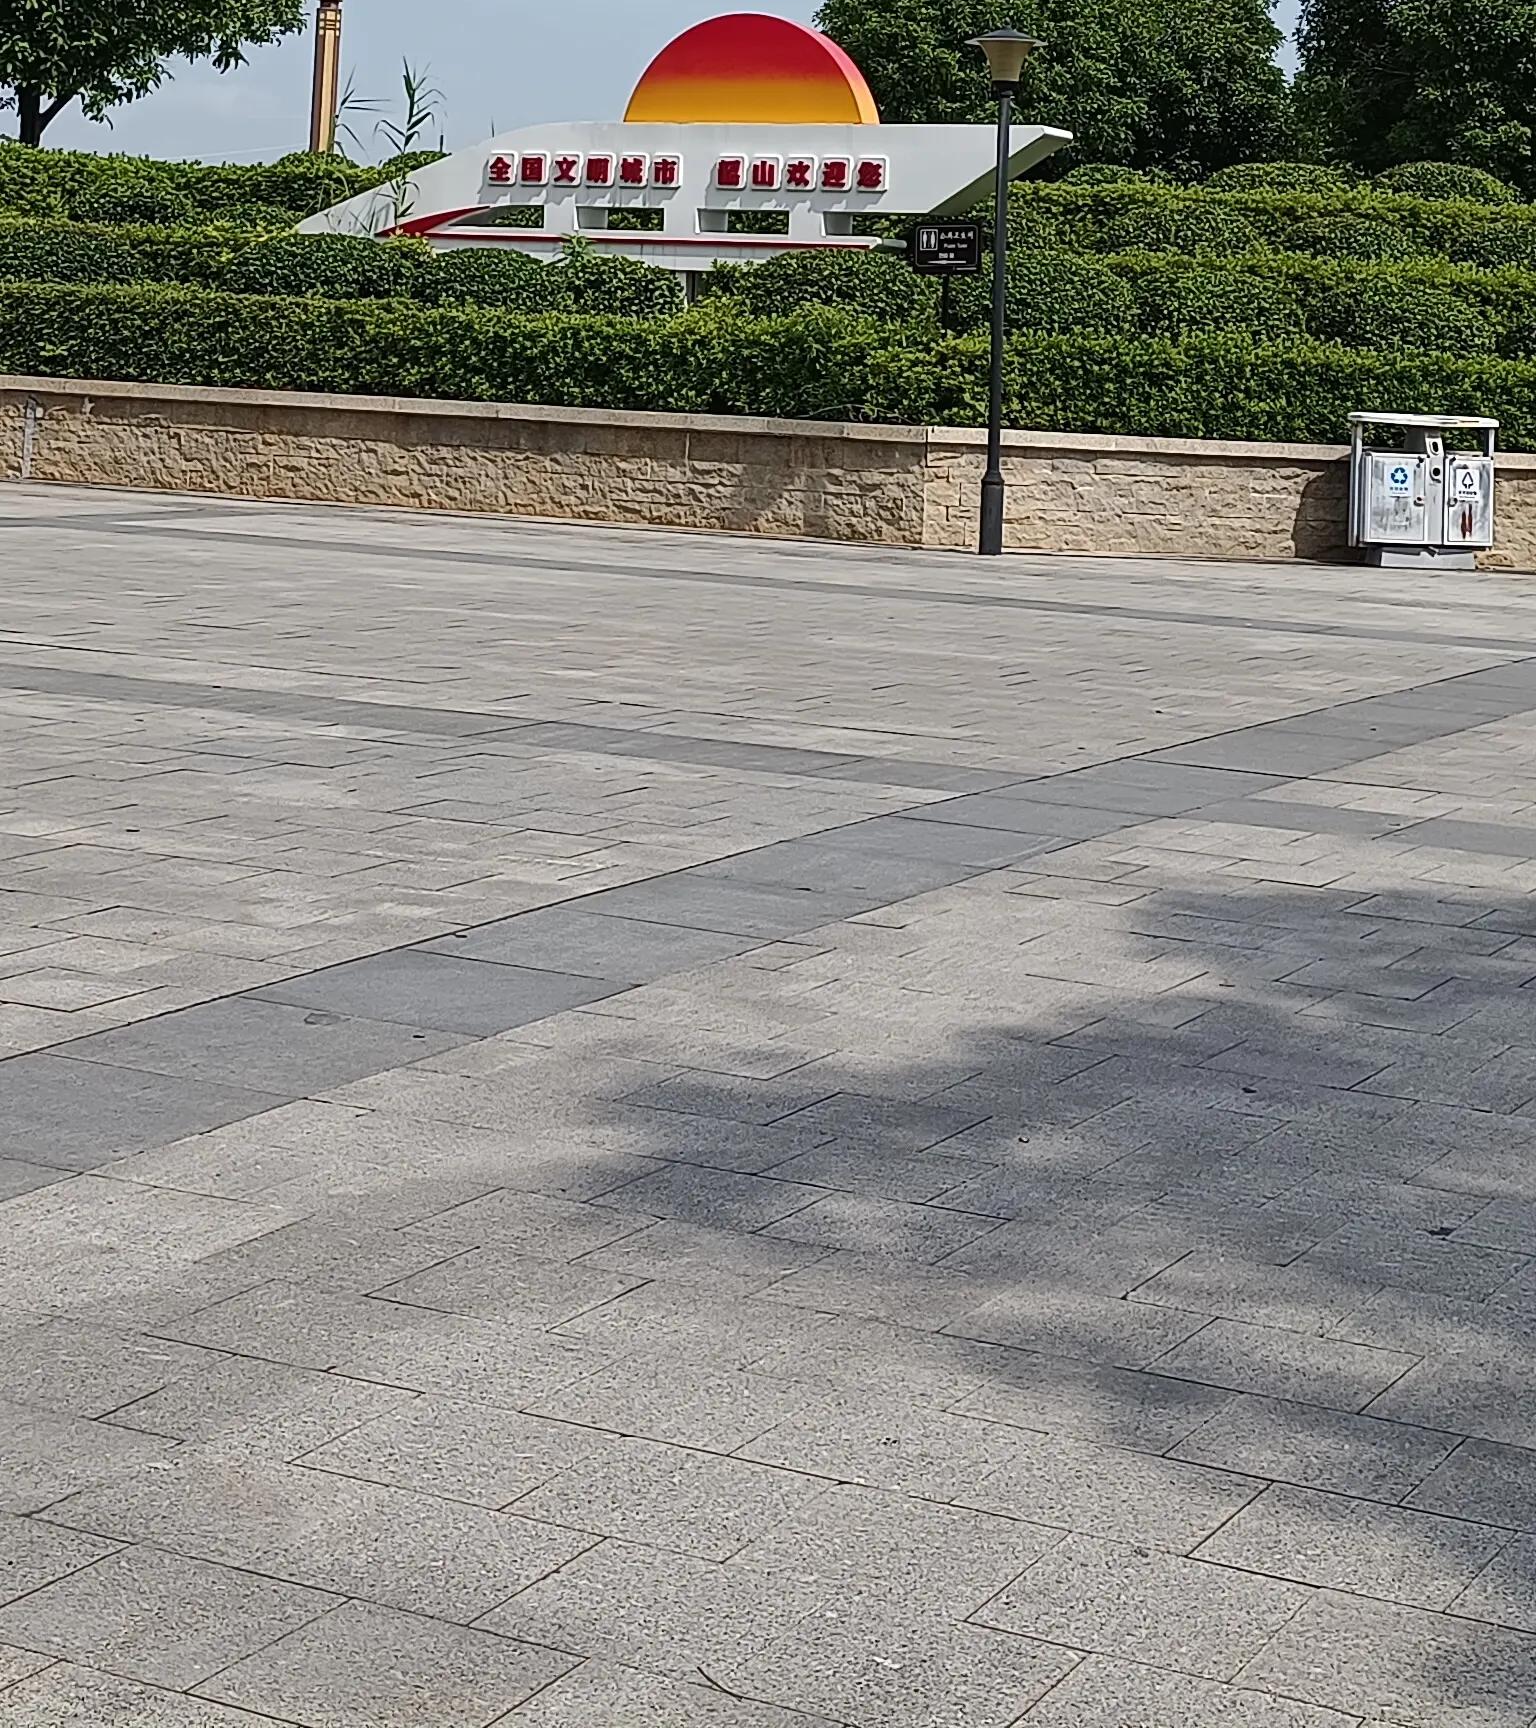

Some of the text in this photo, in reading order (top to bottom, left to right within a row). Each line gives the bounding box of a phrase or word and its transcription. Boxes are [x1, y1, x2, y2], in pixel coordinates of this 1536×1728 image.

[488, 156, 882, 189] 全国文明城市 韶山欢迎您
